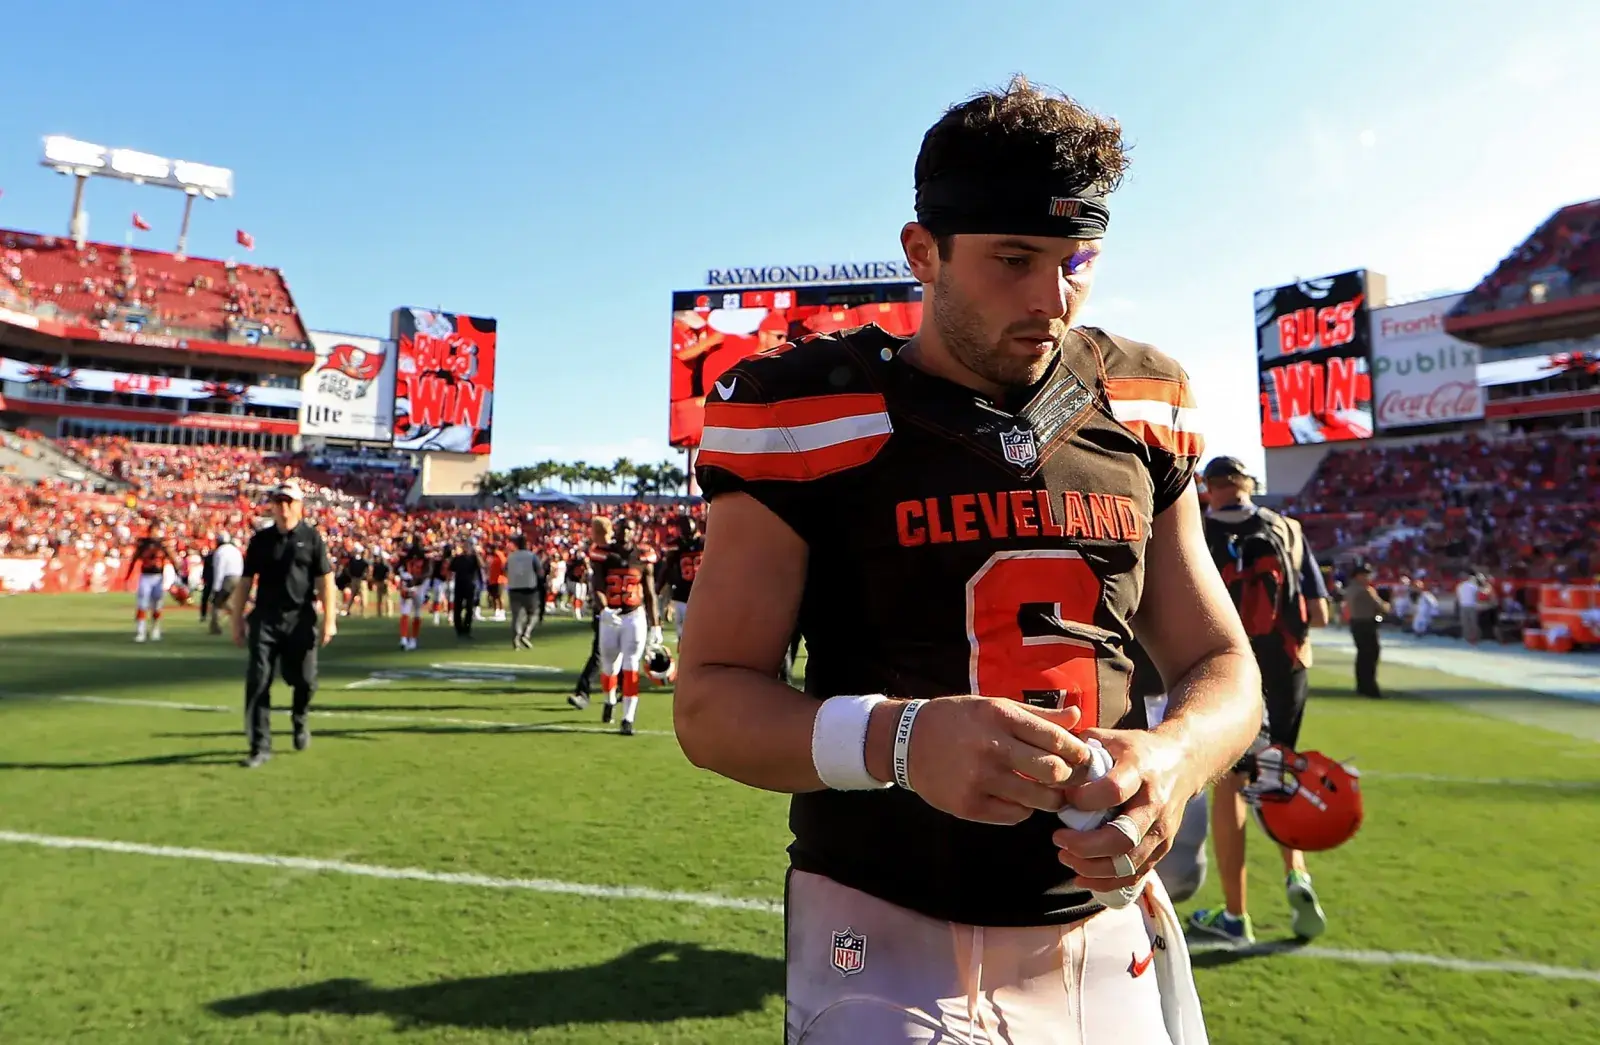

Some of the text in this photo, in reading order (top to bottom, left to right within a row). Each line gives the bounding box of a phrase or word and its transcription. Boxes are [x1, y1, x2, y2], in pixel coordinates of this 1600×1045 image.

[707, 266, 818, 285] RAYMOND
[823, 262, 896, 280] JAMES
[1278, 301, 1356, 354] BUCS
[413, 332, 479, 379] BUCS
[407, 375, 486, 428] WIN
[1271, 356, 1359, 422] WIN
[307, 404, 342, 426] Lite
[1008, 445, 1031, 460] NFL
[895, 490, 1143, 547] CLEVELAND
[965, 549, 1101, 735] 6
[898, 715, 911, 744] HYPE
[836, 949, 859, 969] NFL
